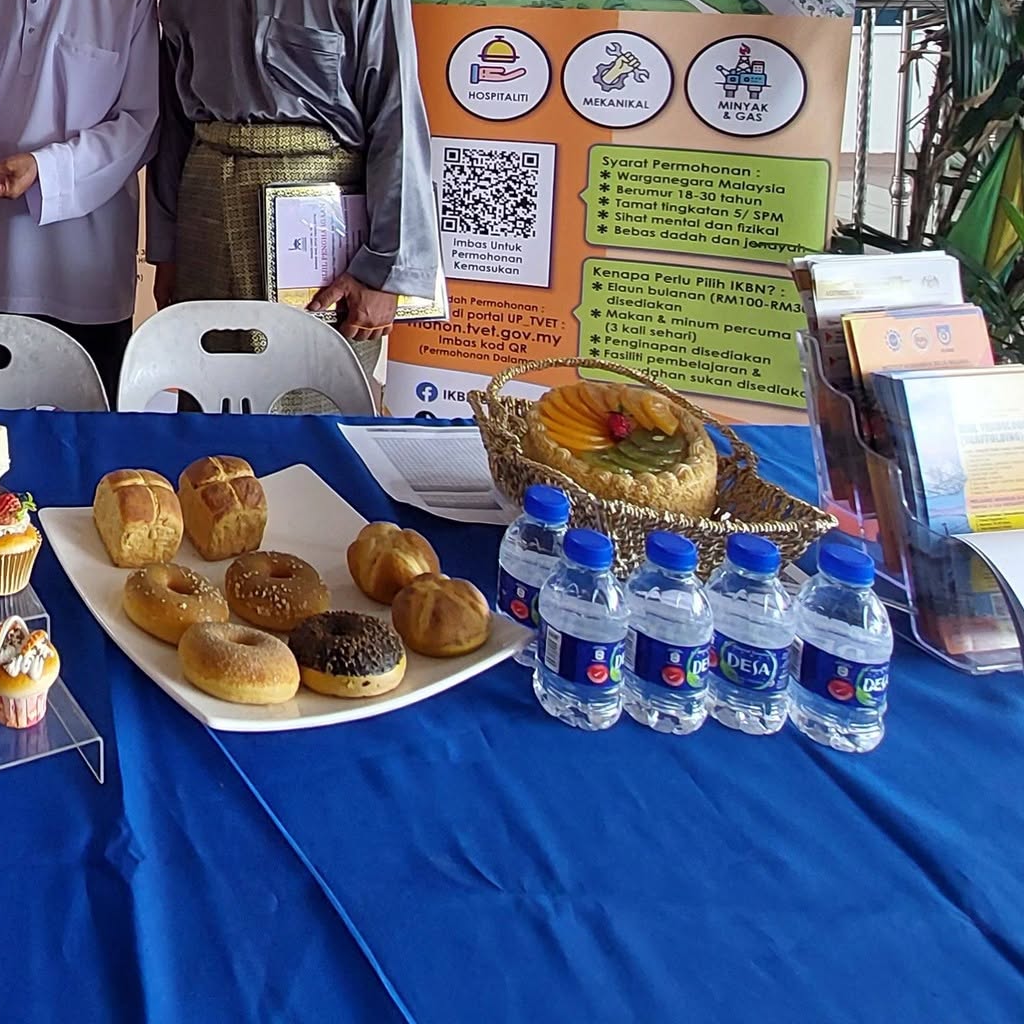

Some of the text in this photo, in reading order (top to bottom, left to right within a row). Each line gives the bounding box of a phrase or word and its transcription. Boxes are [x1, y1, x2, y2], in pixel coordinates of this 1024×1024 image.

[468, 91, 529, 103] HOSPITALITI
[583, 96, 649, 110] MEKANIKAL
[718, 100, 769, 113] MINYAK
[722, 111, 763, 123] & GAS
[602, 156, 751, 177] Syarat Permohonan
[617, 171, 785, 195] Warganegara Malaysia
[617, 186, 762, 206] Berumur 18-30 tahun
[615, 199, 784, 223] Tamat tingkatan 5/ SPM
[615, 212, 779, 236] Sihat mental dan fizikal
[453, 238, 522, 252] Imbas Untuk
[614, 226, 656, 238] Bebas
[660, 229, 707, 242] dadah
[712, 234, 740, 247] dan
[451, 250, 523, 264] Permohonan
[454, 261, 520, 275] Kemasukan
[593, 267, 776, 296] Kenapa Perlu Pilih IKBN?
[607, 283, 644, 294] Elaun
[648, 286, 706, 301] bulanan
[470, 297, 538, 312] Permohonan
[607, 296, 682, 312] disediakan
[452, 309, 558, 328] di portal UP_TVET
[606, 310, 791, 341] Makan & minum percuma
[605, 322, 697, 343] (3 kali sehari)
[419, 345, 490, 361] (Permohonan
[439, 336, 527, 353] Imbas kod QR
[605, 336, 771, 365] Penginapan disediakan
[604, 349, 761, 377] Fasiliti pembelajaran &
[690, 374, 733, 387] sukan
[727, 651, 772, 676] DESA
